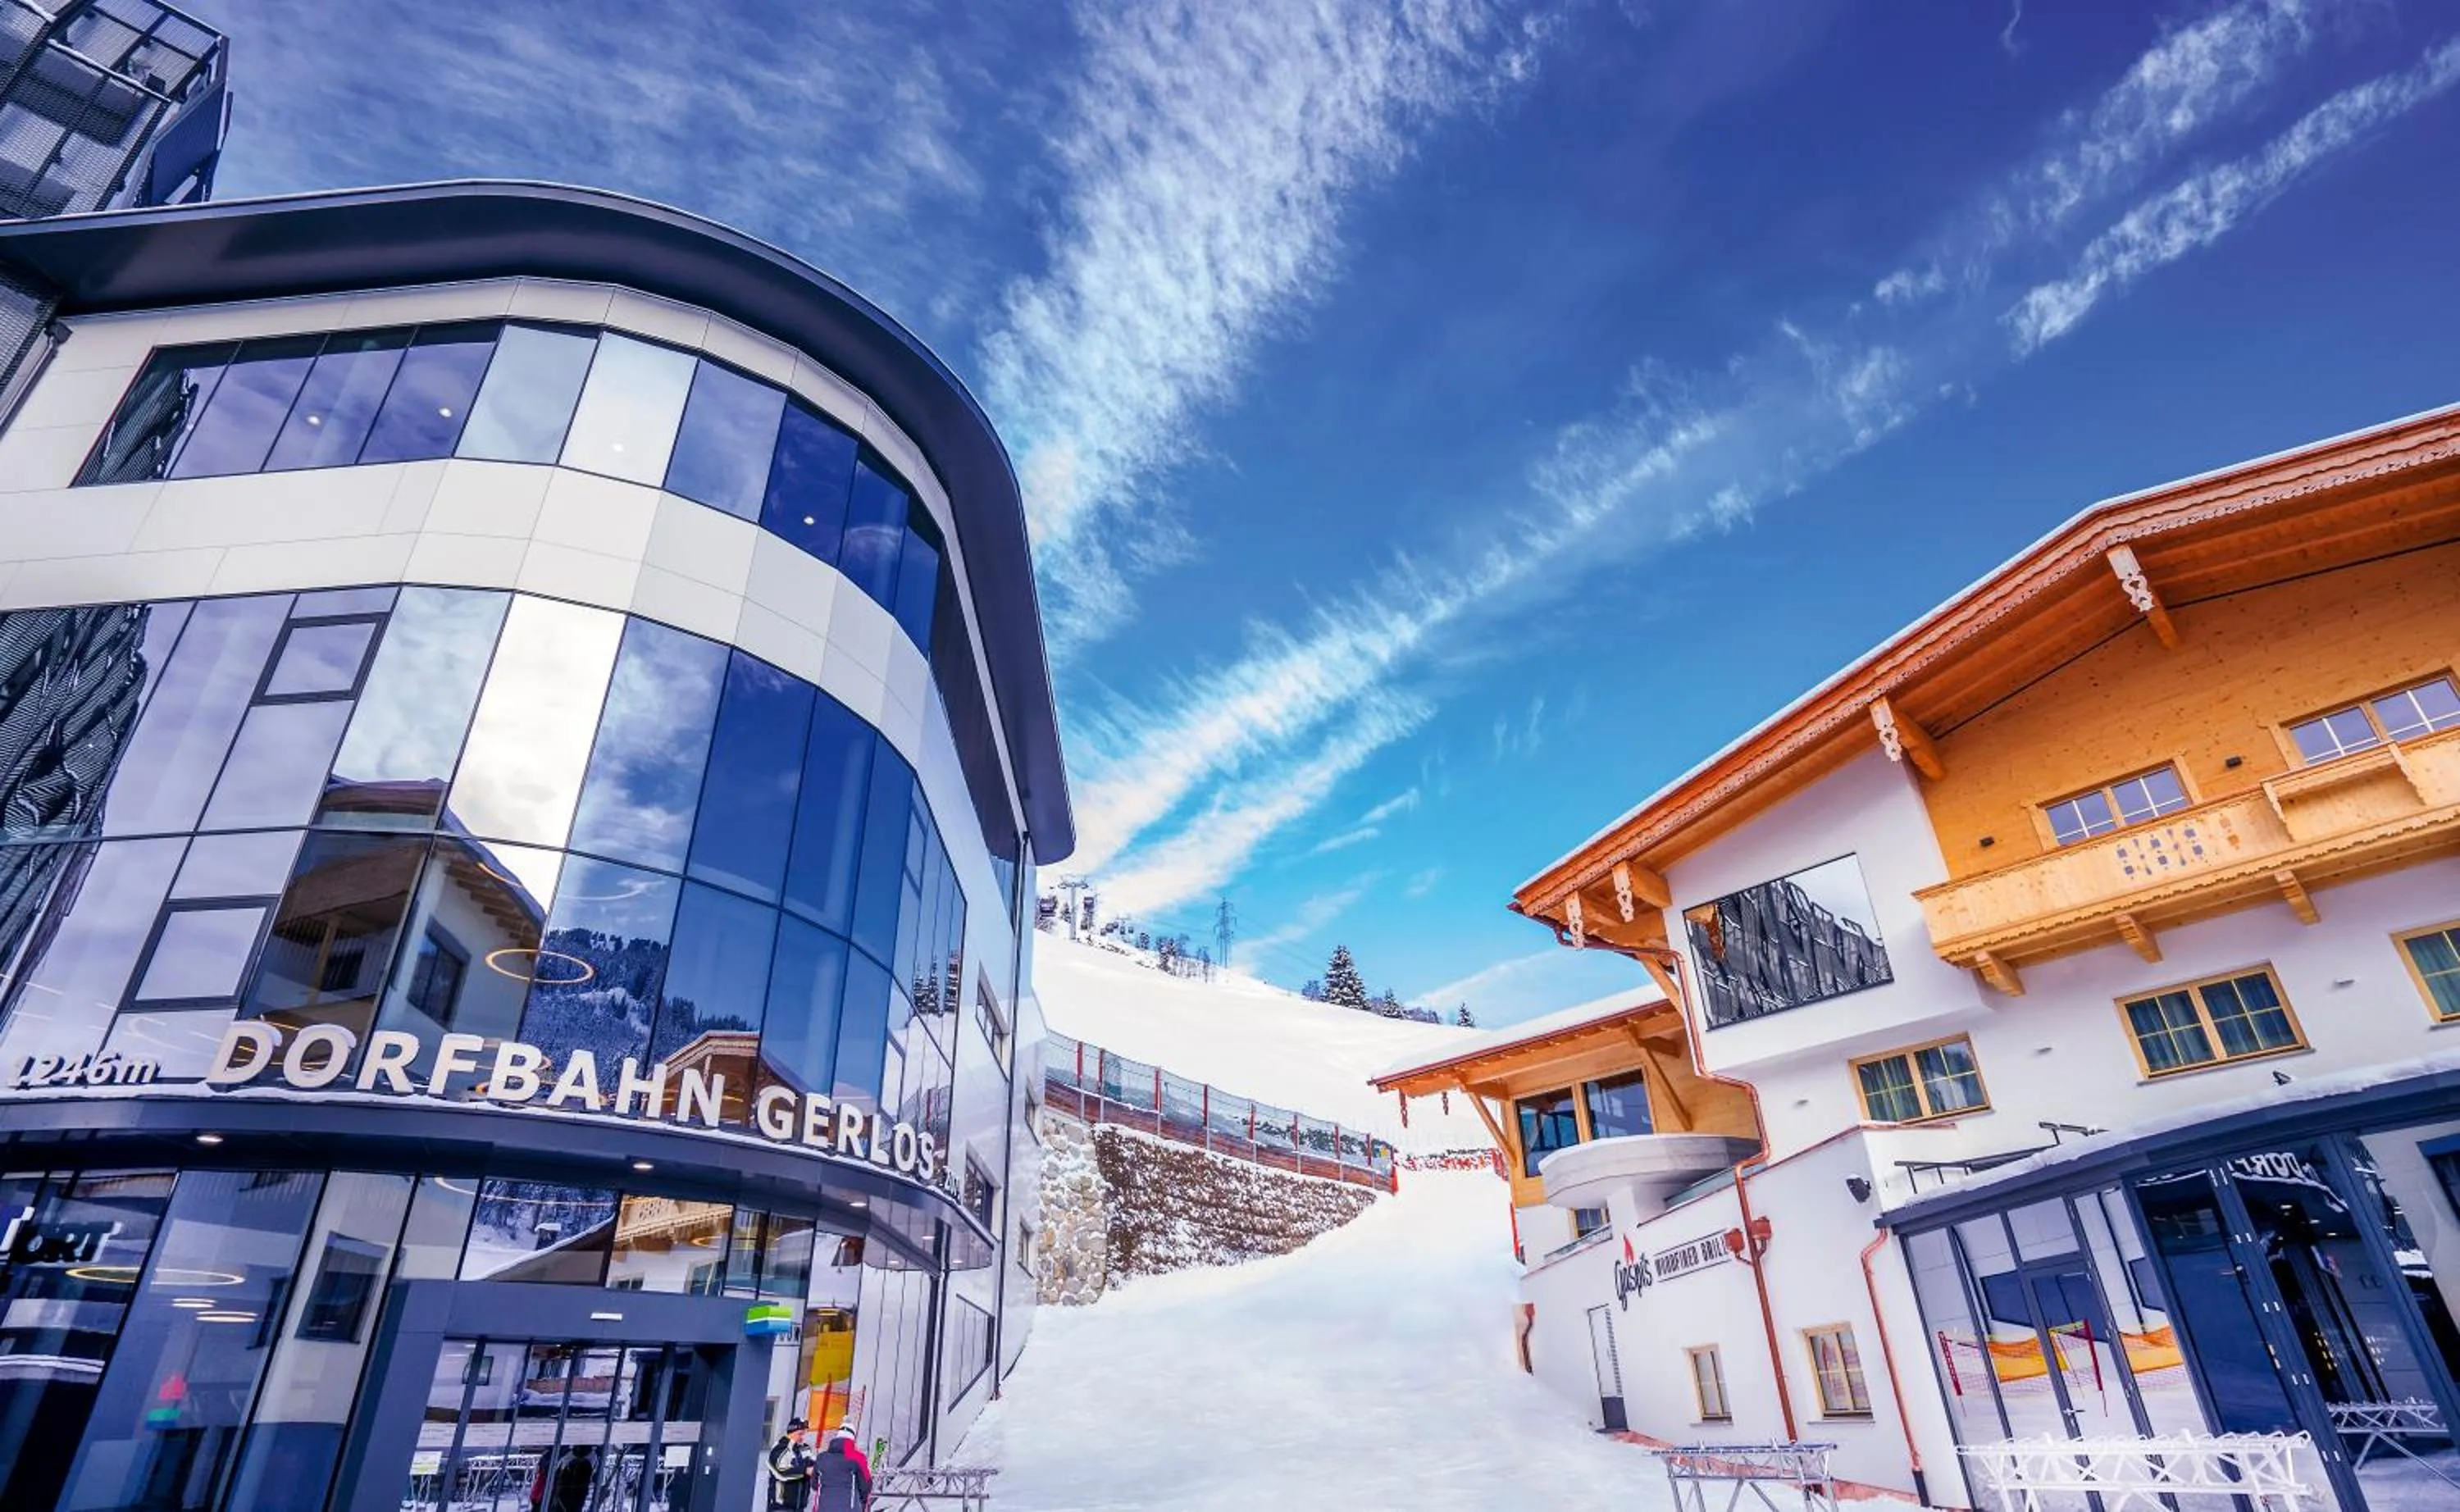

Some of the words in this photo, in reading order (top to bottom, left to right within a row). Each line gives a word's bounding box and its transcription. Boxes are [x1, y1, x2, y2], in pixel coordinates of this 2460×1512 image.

[8, 1055, 157, 1089] 1246m
[206, 1021, 725, 1127] DORFBAHN
[757, 1085, 934, 1180] GERLOS
